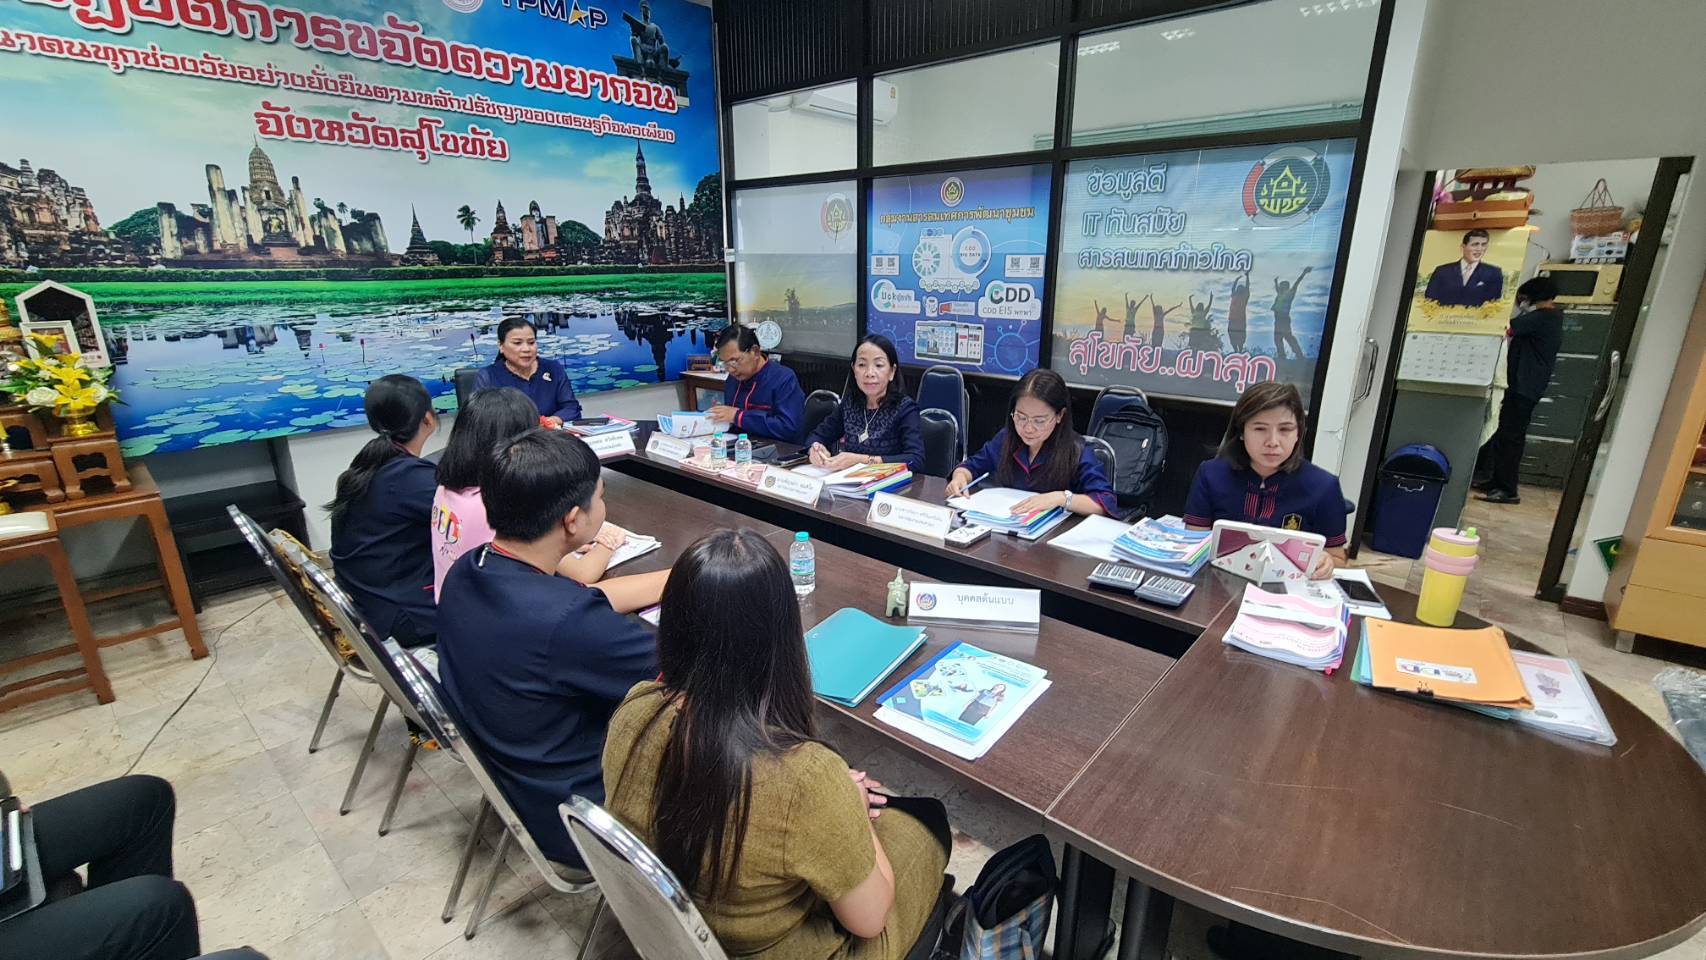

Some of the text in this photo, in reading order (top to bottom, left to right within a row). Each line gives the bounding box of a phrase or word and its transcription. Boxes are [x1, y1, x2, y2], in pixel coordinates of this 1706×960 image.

[253, 100, 508, 162] จังหวัดสุโขทัย
[1087, 161, 1168, 201] ข้อมูลดี
[1082, 205, 1187, 236] IT ทันสมัย
[1077, 243, 1254, 273] สารสนเทศก้าวไกล
[988, 284, 1031, 304] CDD
[956, 592, 1015, 606] บุคคลต้นแบบ
